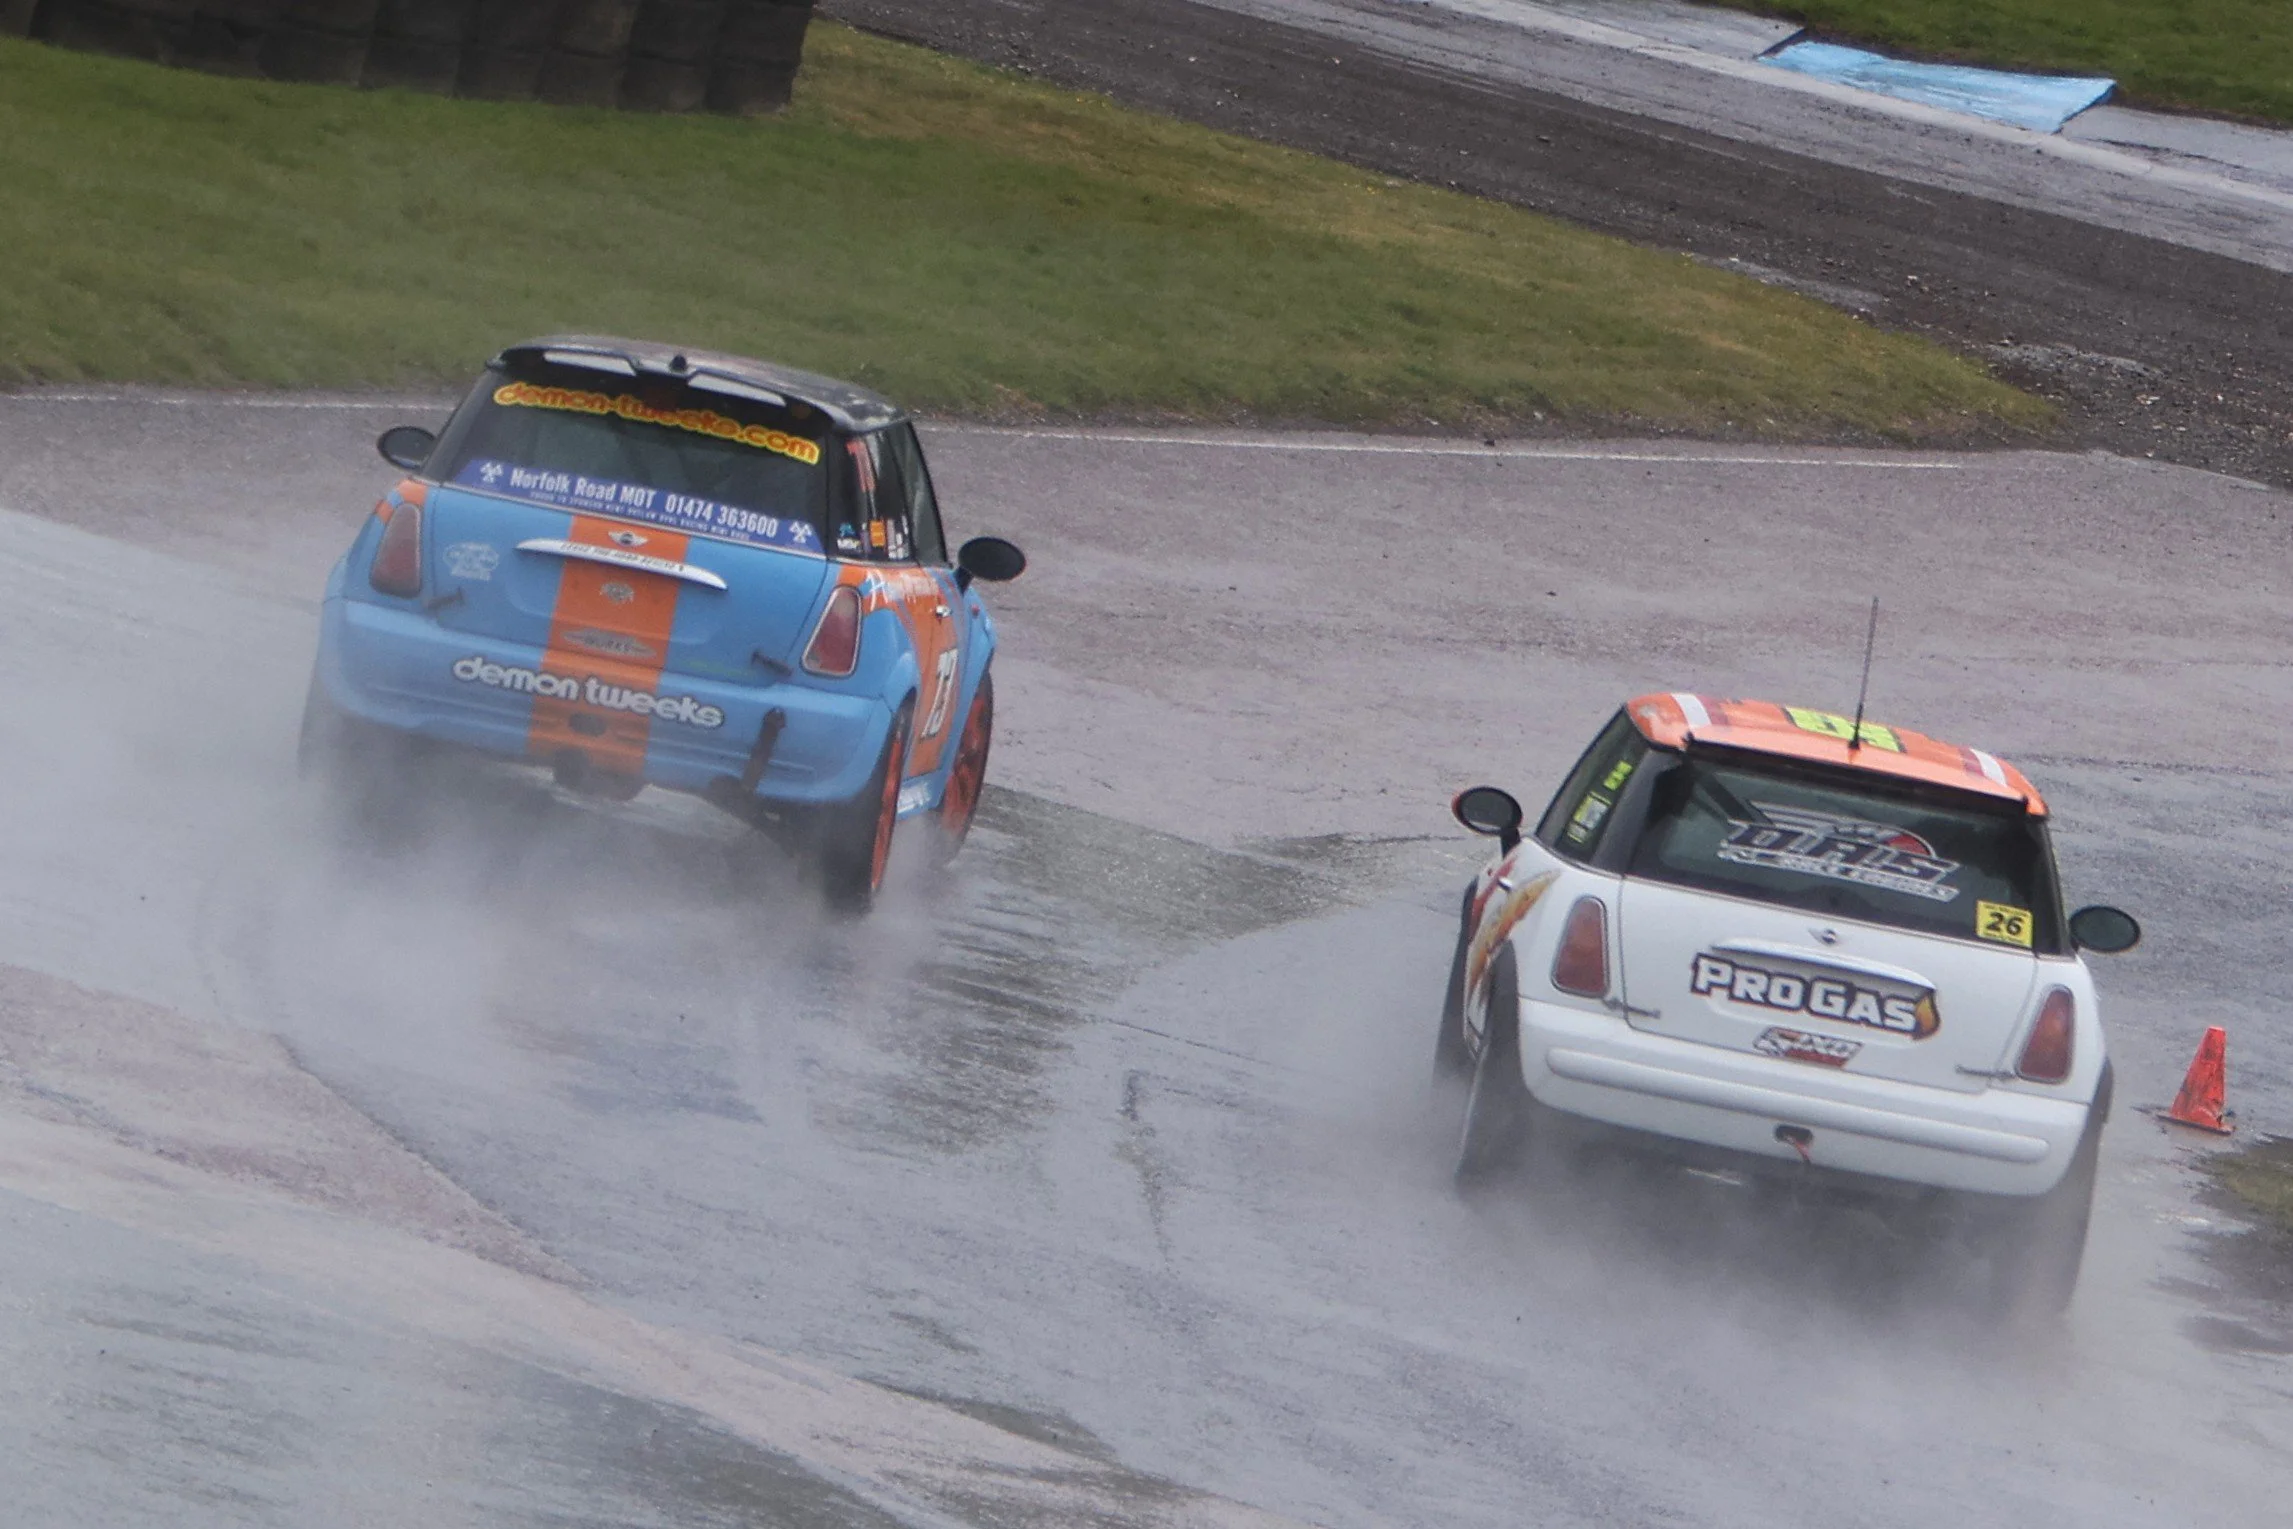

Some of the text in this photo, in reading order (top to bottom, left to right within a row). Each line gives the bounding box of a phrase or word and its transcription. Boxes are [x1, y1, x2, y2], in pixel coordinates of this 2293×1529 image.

[510, 468, 569, 494] Norfolk
[575, 478, 616, 502] Road
[620, 486, 657, 508] MOT
[665, 494, 713, 521] 01474
[717, 507, 778, 538] 363600
[453, 656, 726, 728] demon tweeks
[1986, 911, 2025, 936] 26
